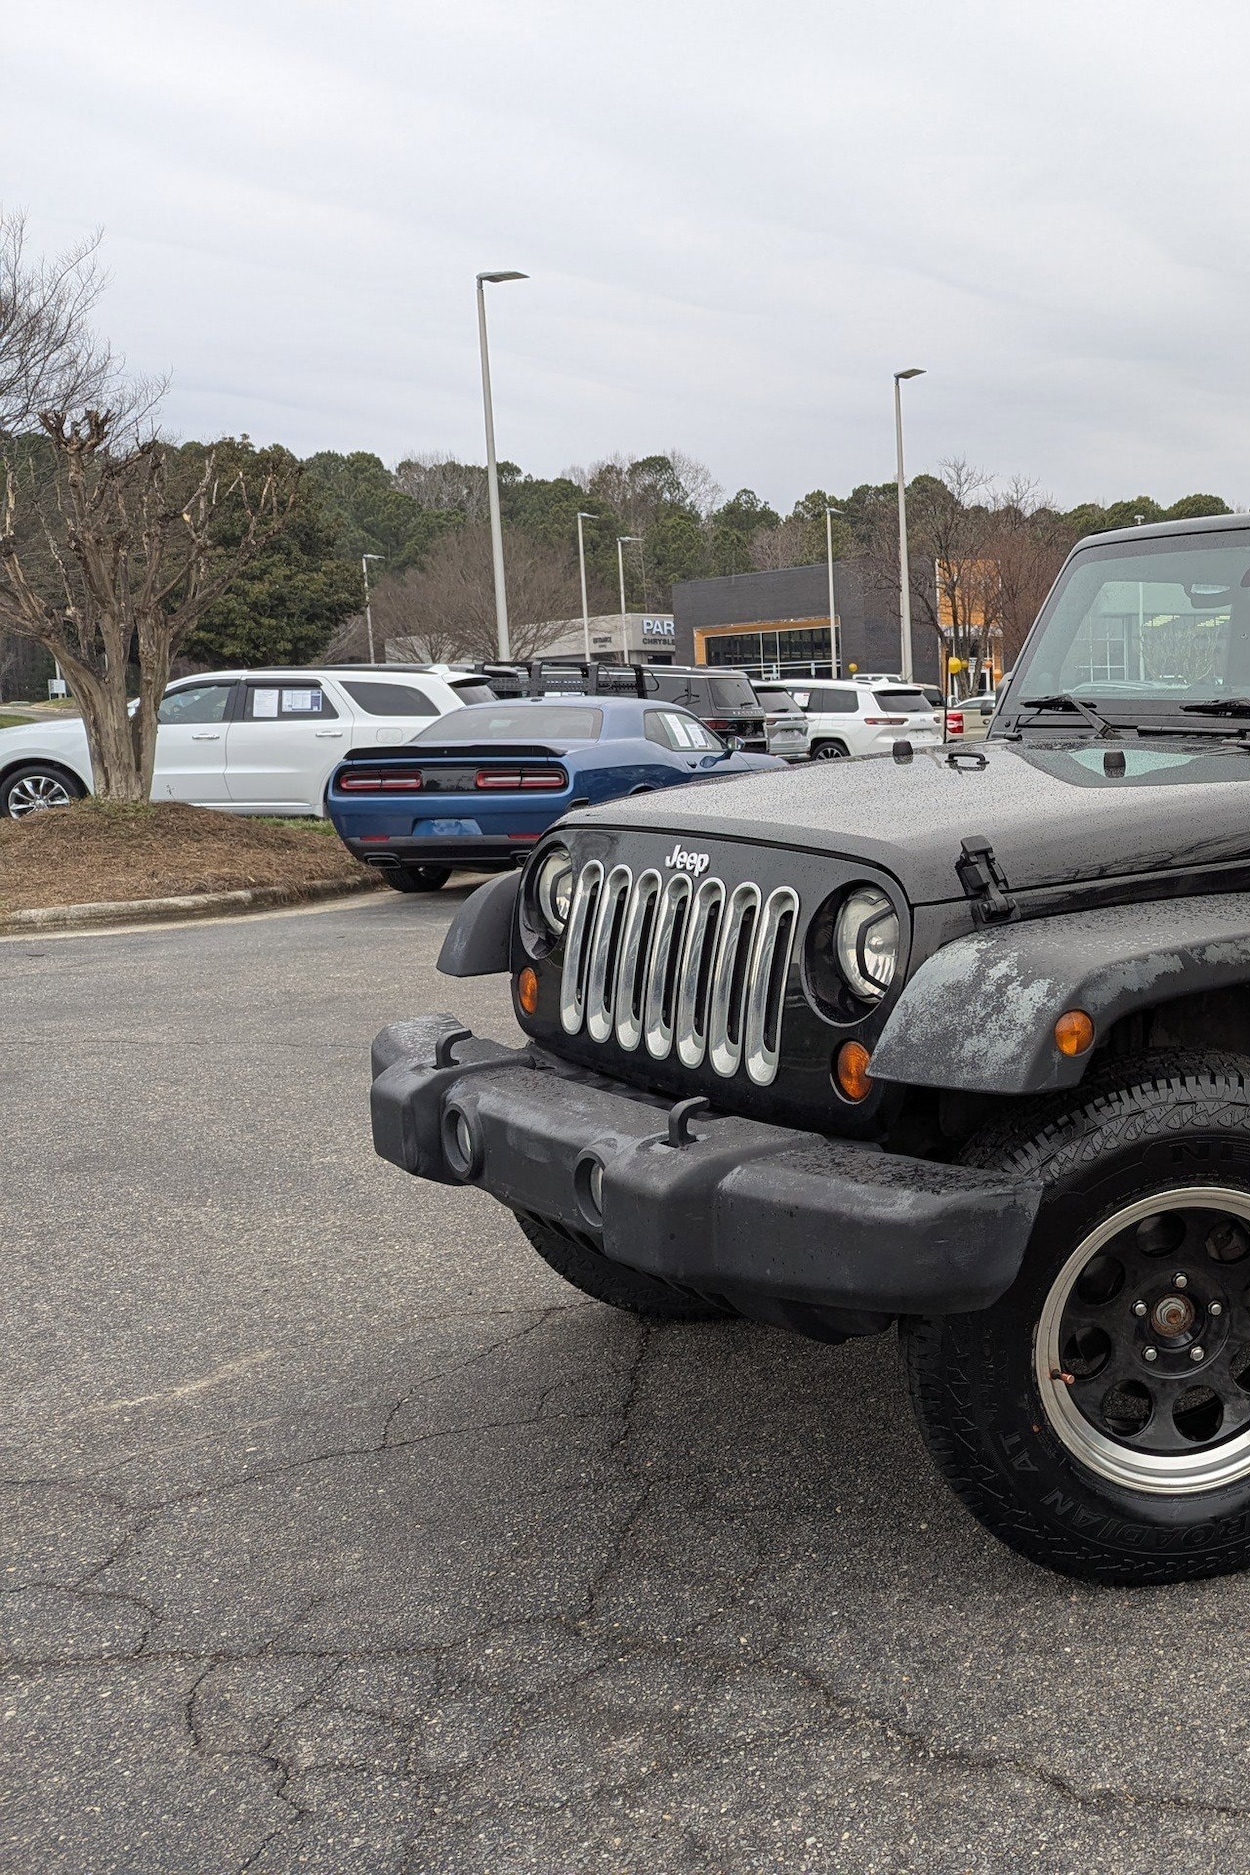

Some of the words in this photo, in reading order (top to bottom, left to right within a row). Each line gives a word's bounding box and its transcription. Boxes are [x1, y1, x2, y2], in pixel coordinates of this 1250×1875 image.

[665, 845, 710, 878] Jeep
[999, 1431, 1040, 1472] AT
[1040, 1486, 1250, 1549] ROADIAN
